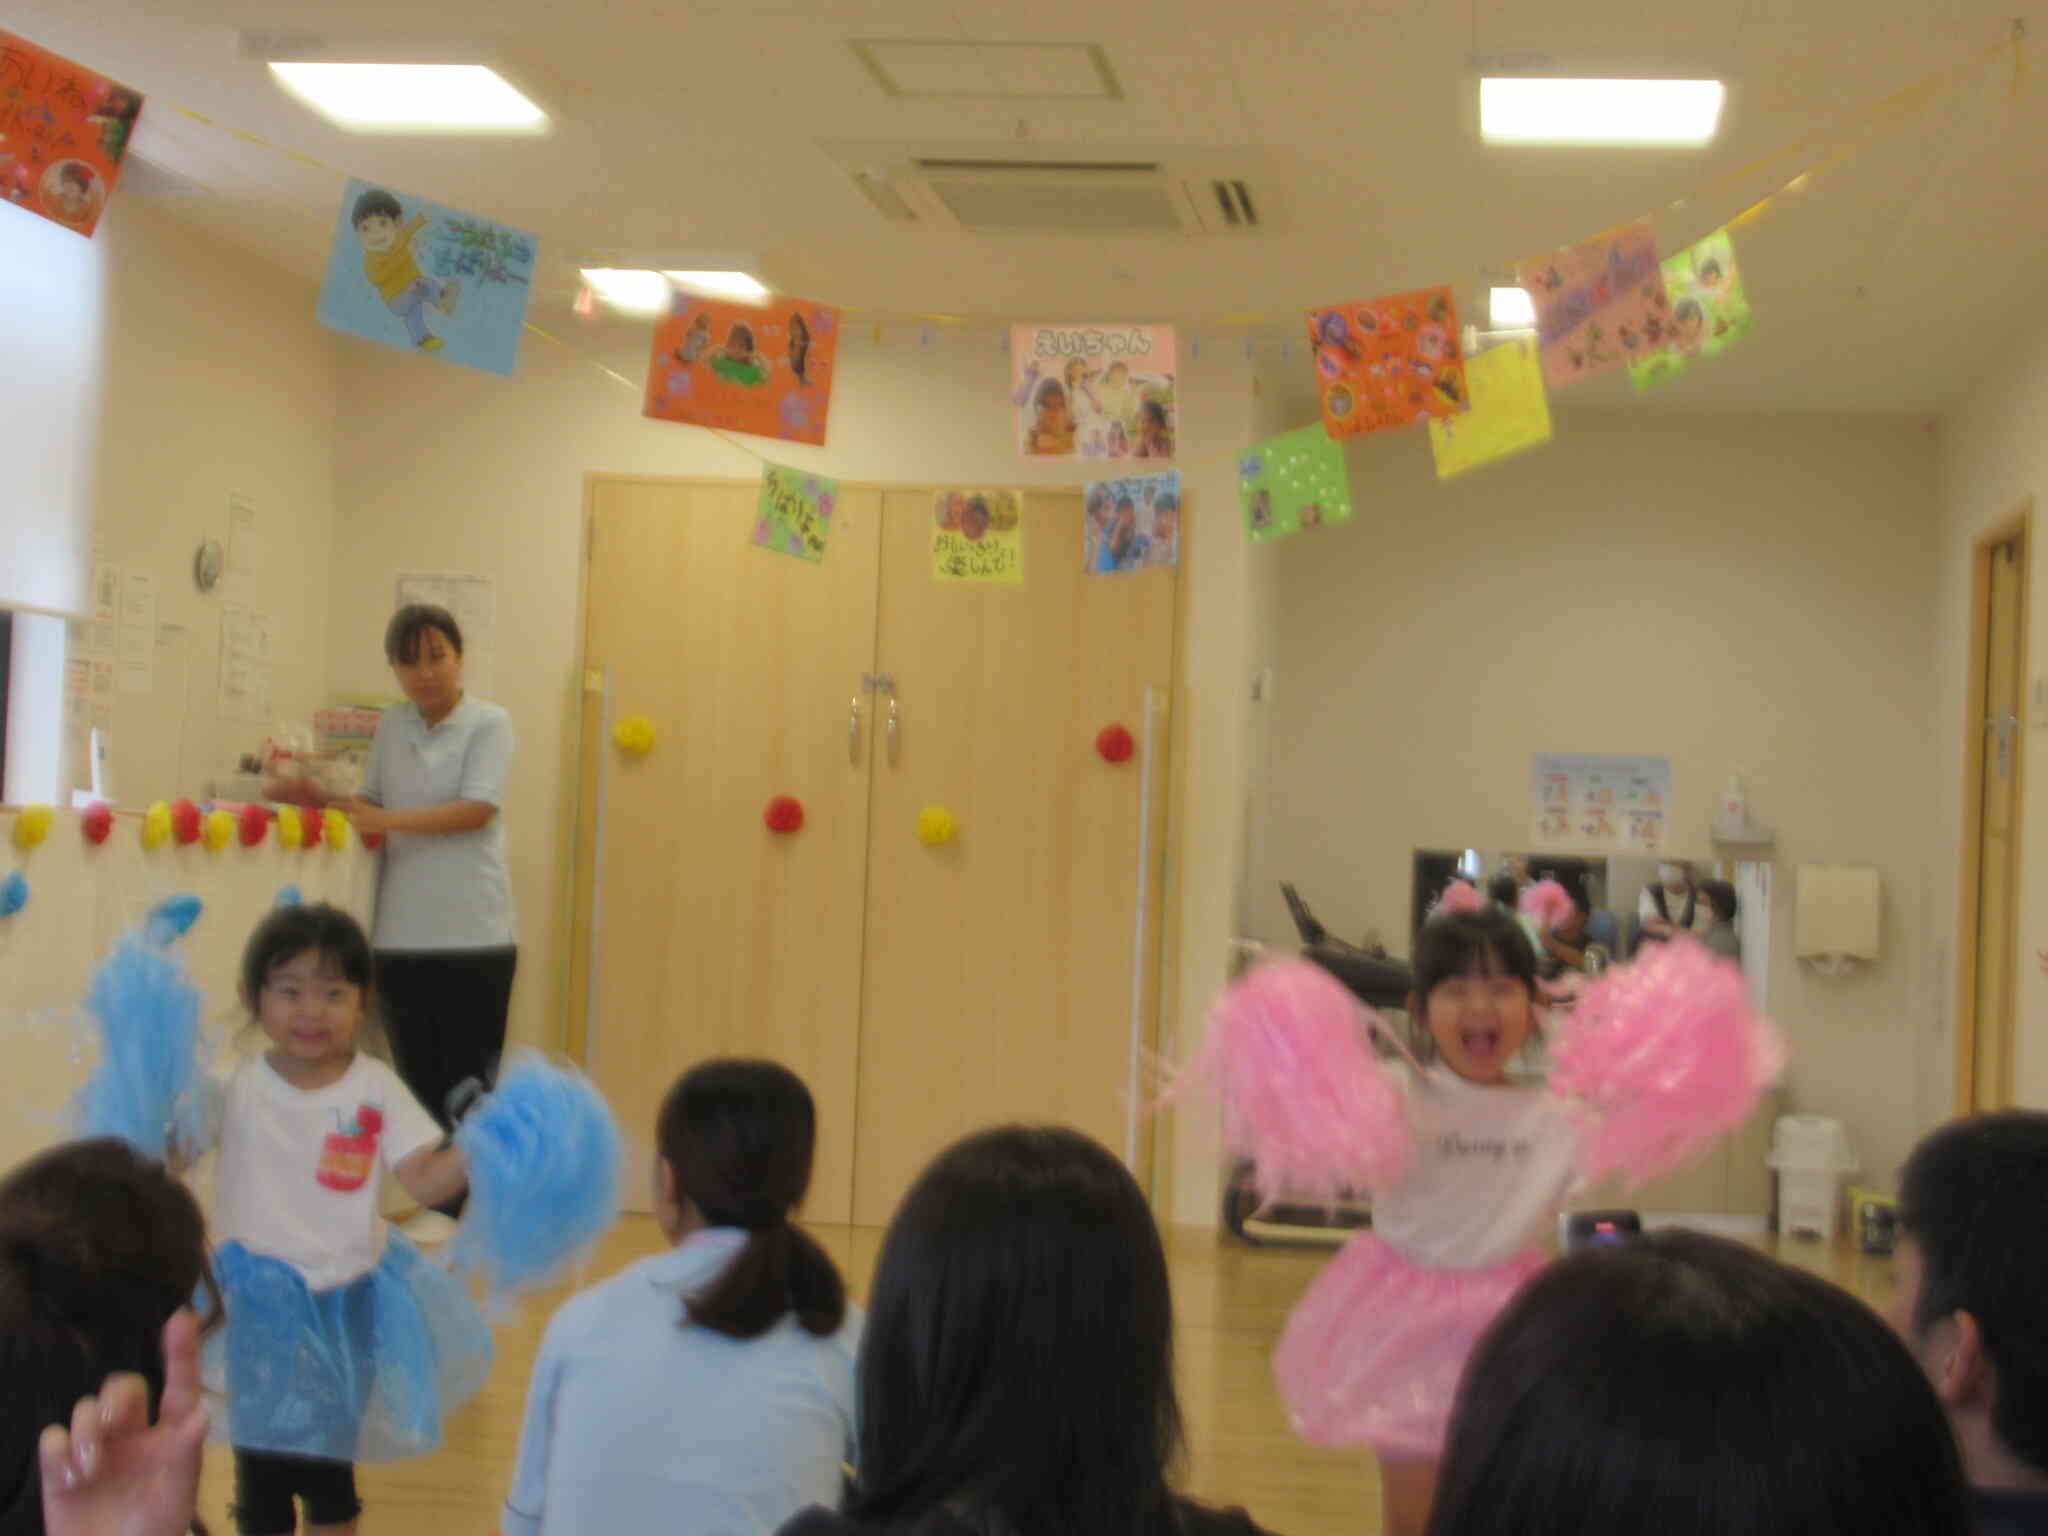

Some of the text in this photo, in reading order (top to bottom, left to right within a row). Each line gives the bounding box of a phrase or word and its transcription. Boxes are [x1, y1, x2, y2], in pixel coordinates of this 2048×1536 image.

[1036, 328, 1152, 358] えいちゃん
